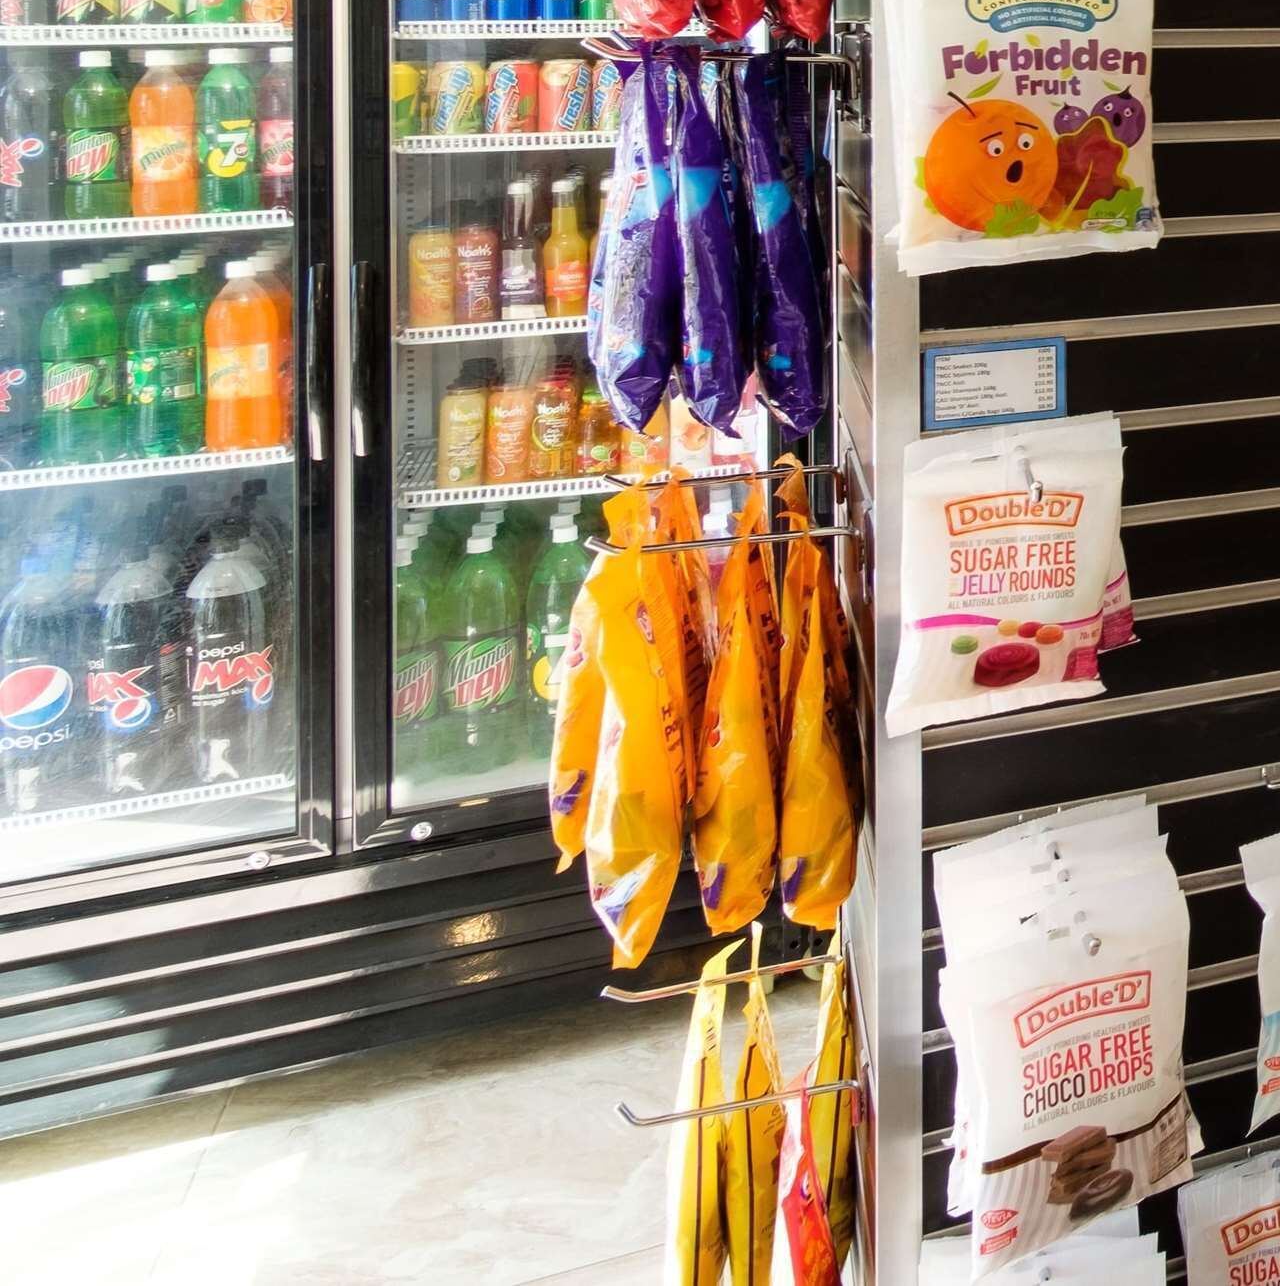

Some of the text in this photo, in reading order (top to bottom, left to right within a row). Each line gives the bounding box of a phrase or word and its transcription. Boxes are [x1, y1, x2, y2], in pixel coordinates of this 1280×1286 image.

[942, 39, 1147, 79] Forbidden
[1016, 75, 1081, 96] Fruit
[950, 540, 1076, 574] SUGAR FREE
[954, 567, 1076, 596] JELLY ROUNDS
[192, 644, 274, 691] MAX
[199, 641, 245, 660] pepsi
[1023, 1025, 1153, 1091] SUGAR FREE
[1023, 1052, 1153, 1118] CHOCO DROPS
[1072, 1093, 1108, 1114] COLOURS
[1118, 1077, 1156, 1099] FLAVOURS
